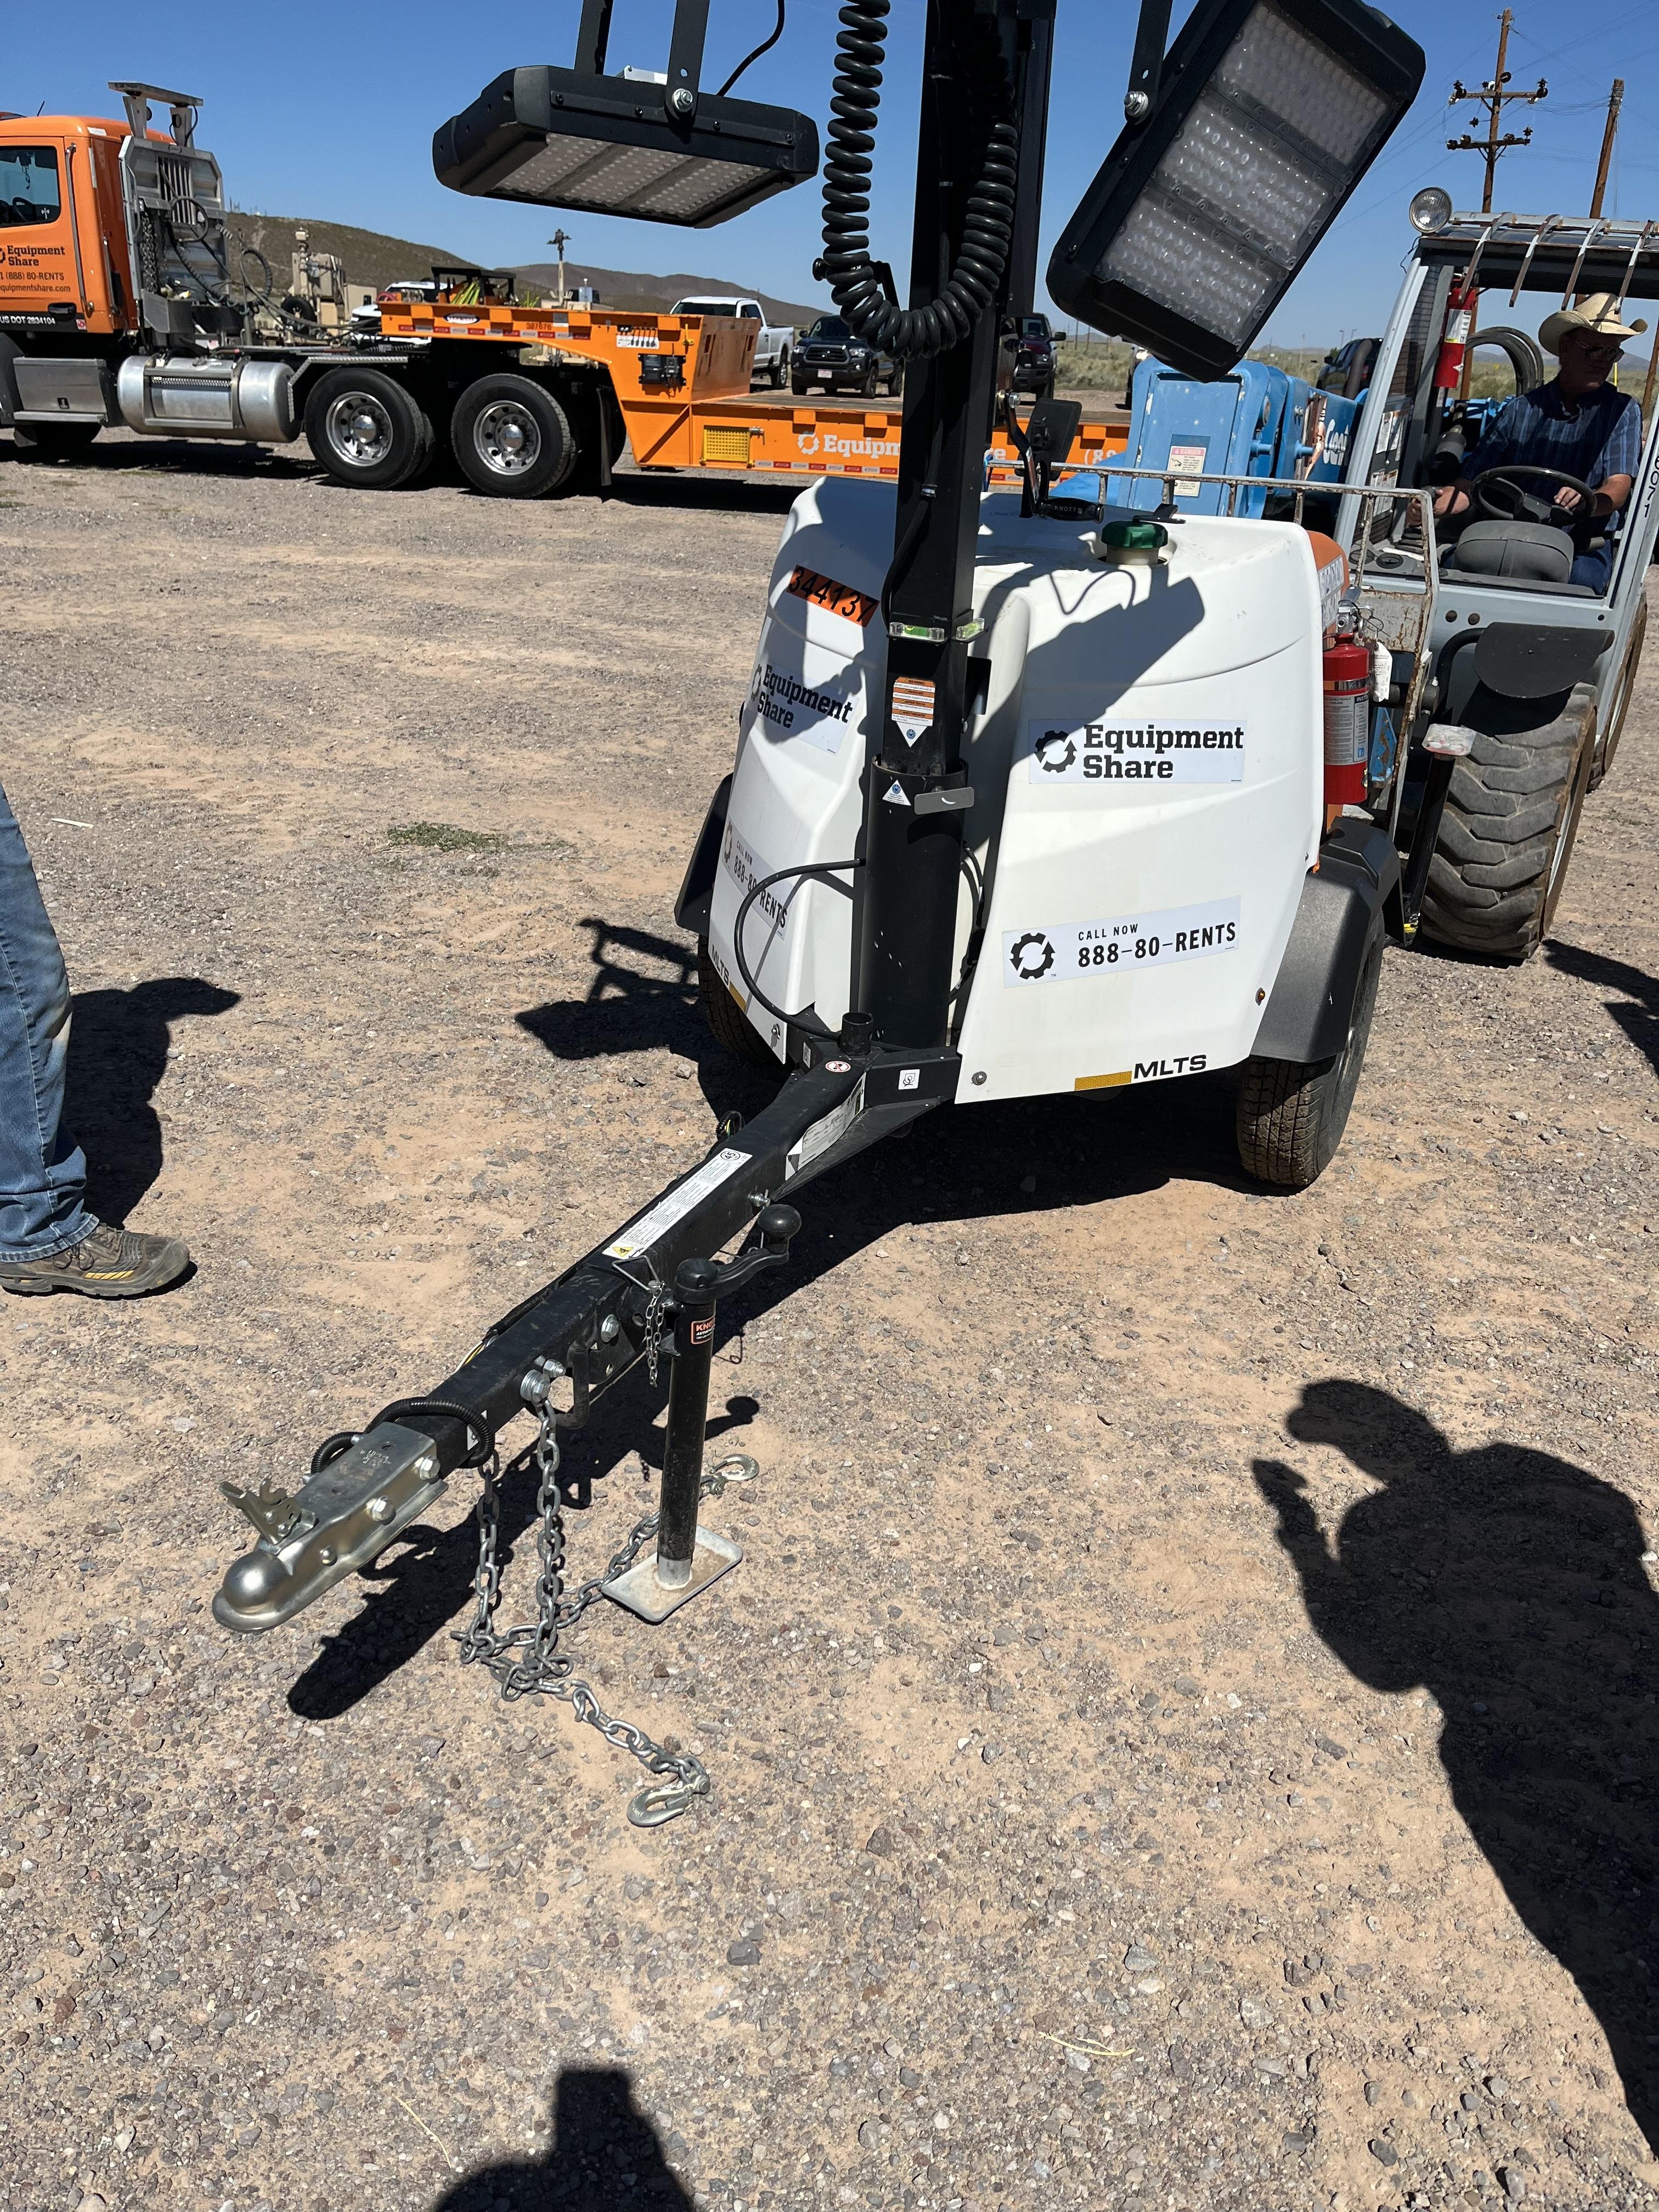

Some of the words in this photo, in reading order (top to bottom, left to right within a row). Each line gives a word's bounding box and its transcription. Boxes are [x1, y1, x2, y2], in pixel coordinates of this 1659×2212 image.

[7, 245, 65, 257] Equipment
[8, 256, 39, 266] Share
[0, 283, 71, 293] quipmentshare.com
[6, 272, 25, 280] (888)
[26, 272, 64, 280] 80-RENTS
[0, 315, 10, 324] US
[10, 315, 26, 324] DOT
[823, 435, 900, 459] Equipm
[789, 566, 880, 623] 344137
[763, 664, 853, 724] Equipment
[758, 691, 794, 729] Share
[1084, 725, 1244, 754] Equipment
[1084, 755, 1173, 778] Share
[744, 851, 753, 866] NOW
[734, 855, 787, 928] 888-80RENTS
[1078, 928, 1107, 940] CALL
[1113, 924, 1138, 936] NOW
[1078, 922, 1235, 967] 888-80-RENTS
[712, 944, 729, 986] MLTS
[1134, 1054, 1206, 1079] MLTS
